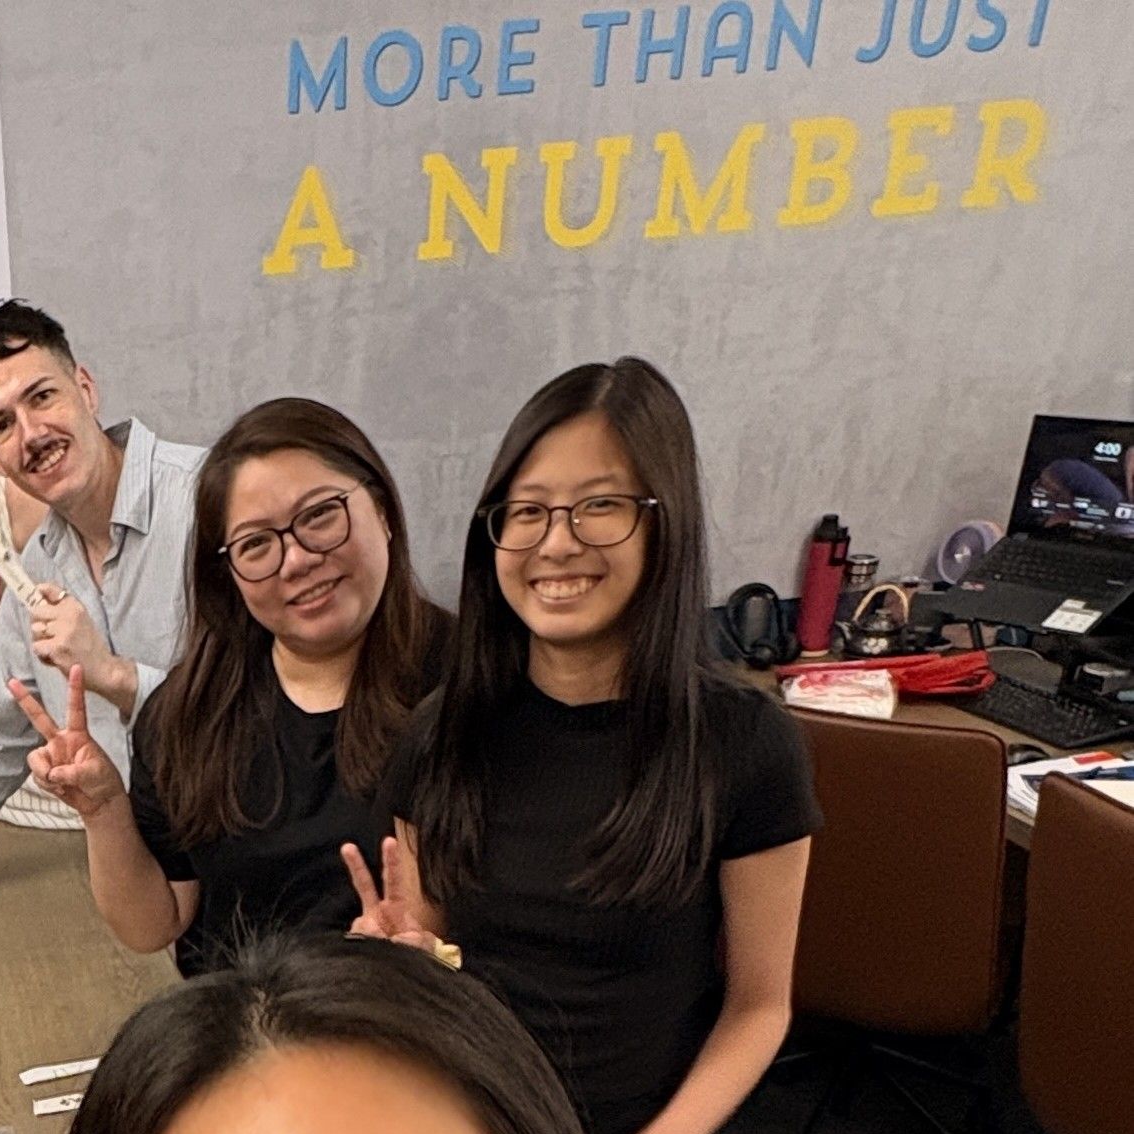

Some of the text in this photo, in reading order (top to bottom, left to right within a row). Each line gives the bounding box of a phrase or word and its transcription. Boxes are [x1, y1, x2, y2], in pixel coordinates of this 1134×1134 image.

[289, 21, 539, 113] MORE
[582, 0, 820, 88] THAN
[262, 100, 1048, 277] A NUMBER
